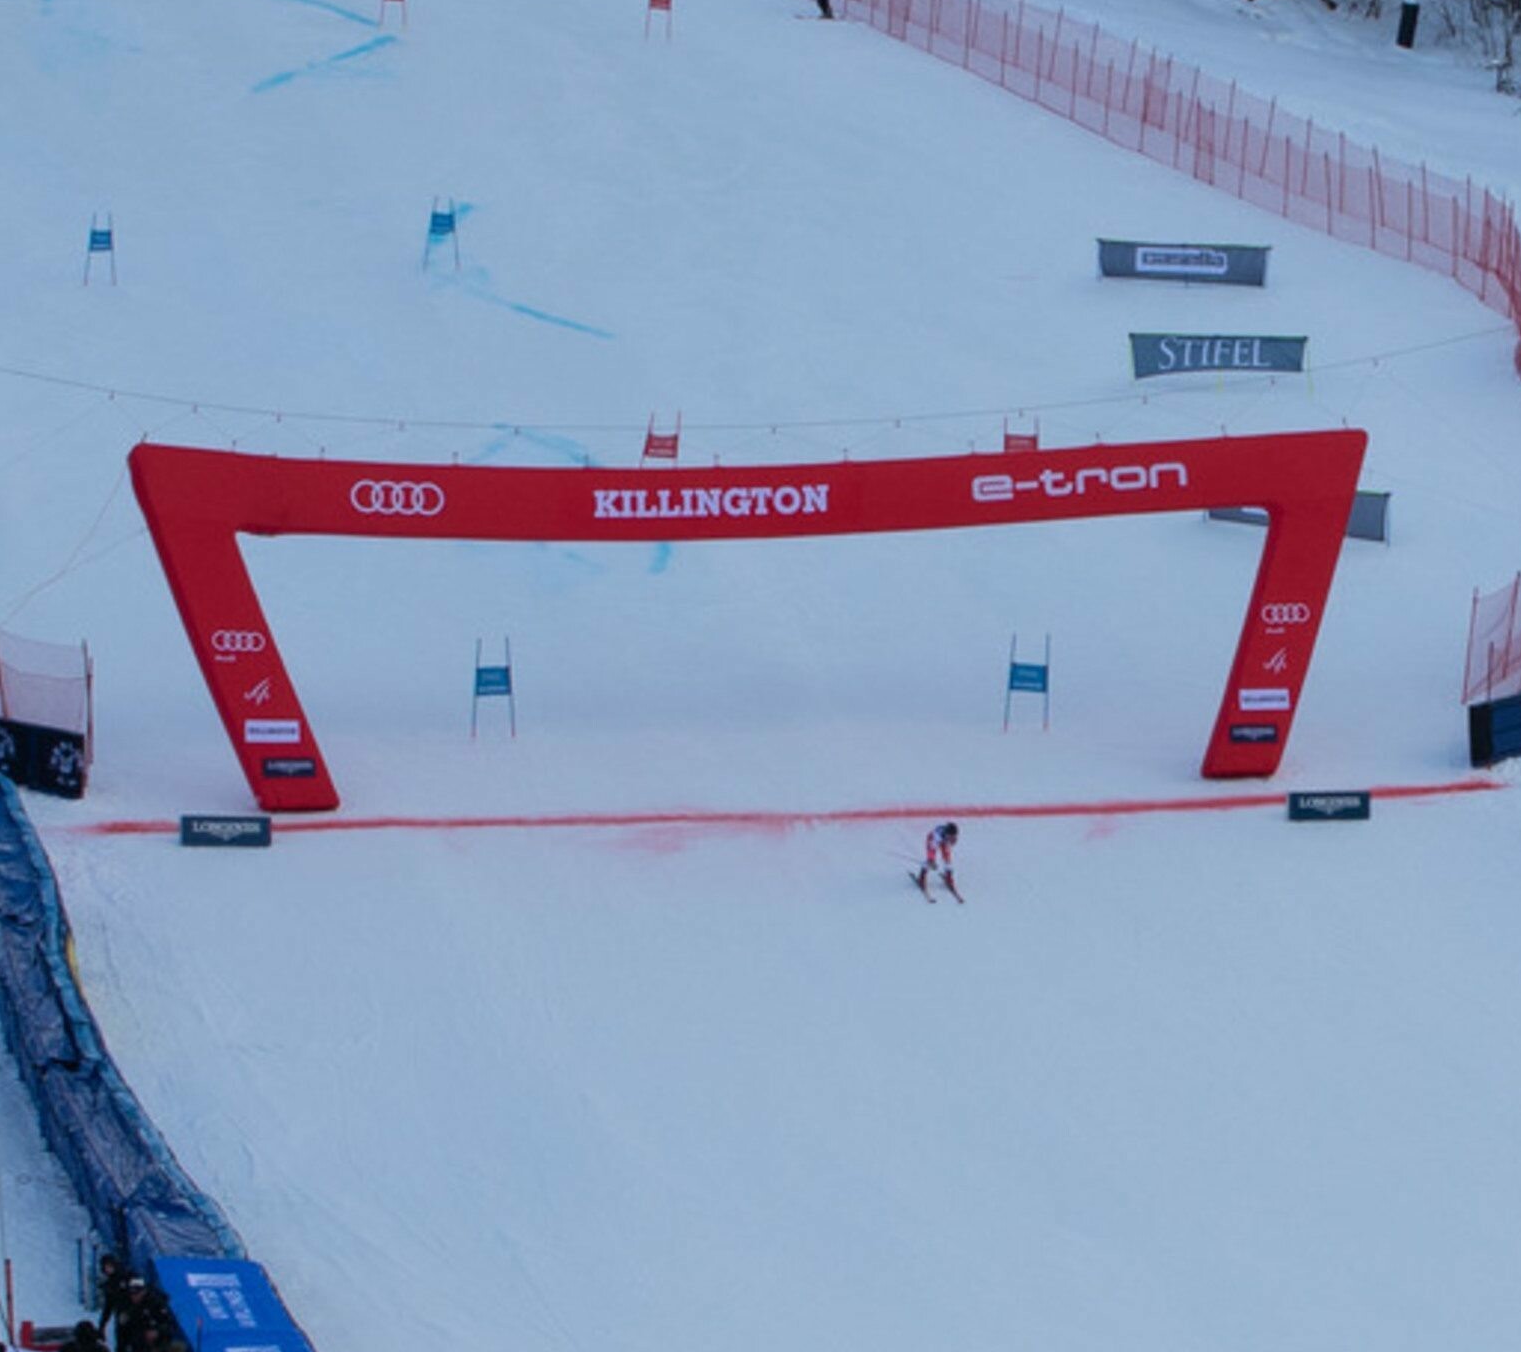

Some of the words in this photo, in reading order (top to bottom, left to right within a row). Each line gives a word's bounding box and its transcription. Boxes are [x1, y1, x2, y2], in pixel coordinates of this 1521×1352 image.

[1159, 336, 1271, 369] STIFEL
[972, 461, 1188, 501] e-tron
[594, 484, 830, 519] KILLINGTON
